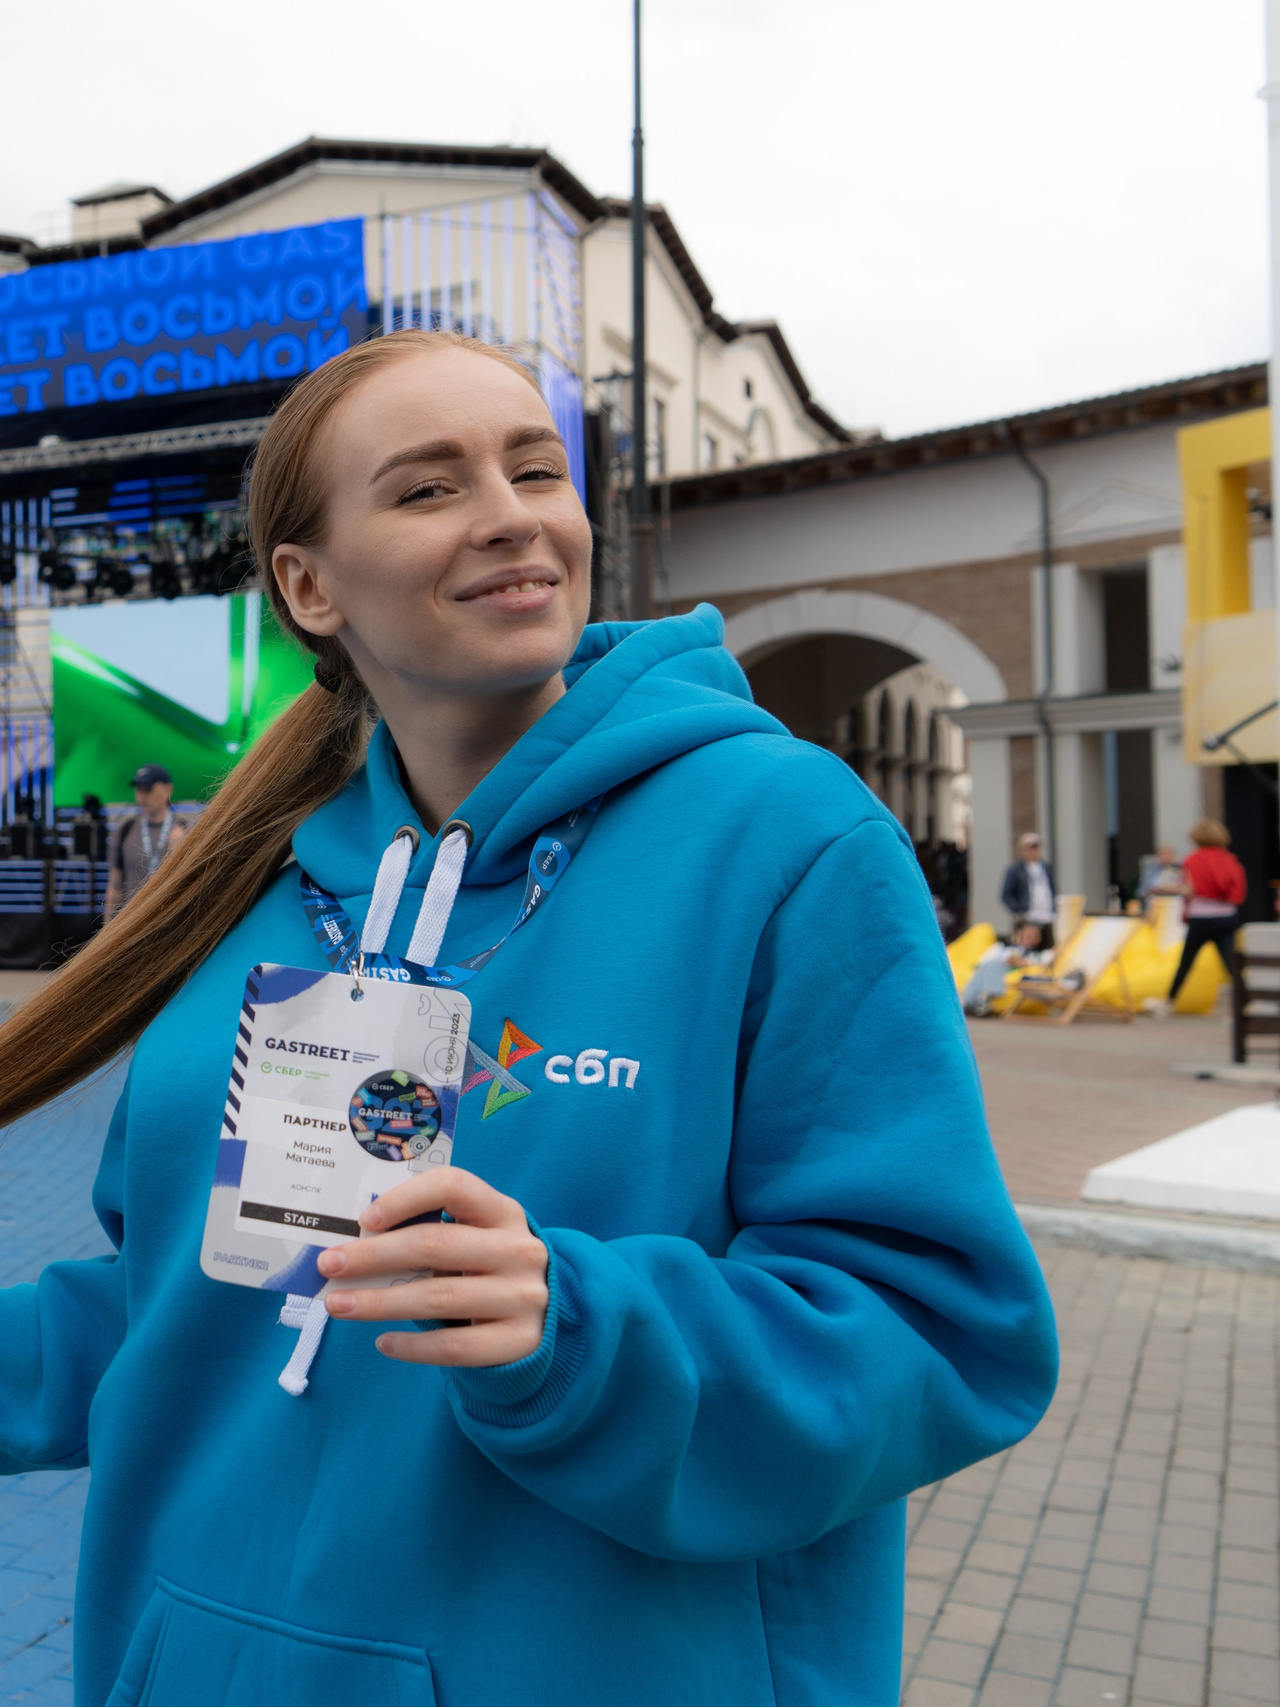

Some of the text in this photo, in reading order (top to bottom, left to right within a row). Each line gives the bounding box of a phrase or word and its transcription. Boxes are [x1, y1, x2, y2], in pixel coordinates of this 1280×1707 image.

[83, 259, 368, 354] ВОСЬМОЙ
[64, 317, 350, 407] ВОСЬМОЙ
[450, 1013, 461, 1035] 2023
[265, 1037, 350, 1061] GASTREET
[446, 1036, 457, 1065] ИЮНЯ
[275, 1066, 302, 1077] СБЕР
[283, 1114, 347, 1132] ПАРТНЕР
[358, 1107, 413, 1120] GASTREET
[293, 1140, 332, 1154] Мария
[285, 1152, 336, 1168] Матаева
[283, 1211, 320, 1227] STAFF
[213, 1251, 269, 1271] PARTNER
